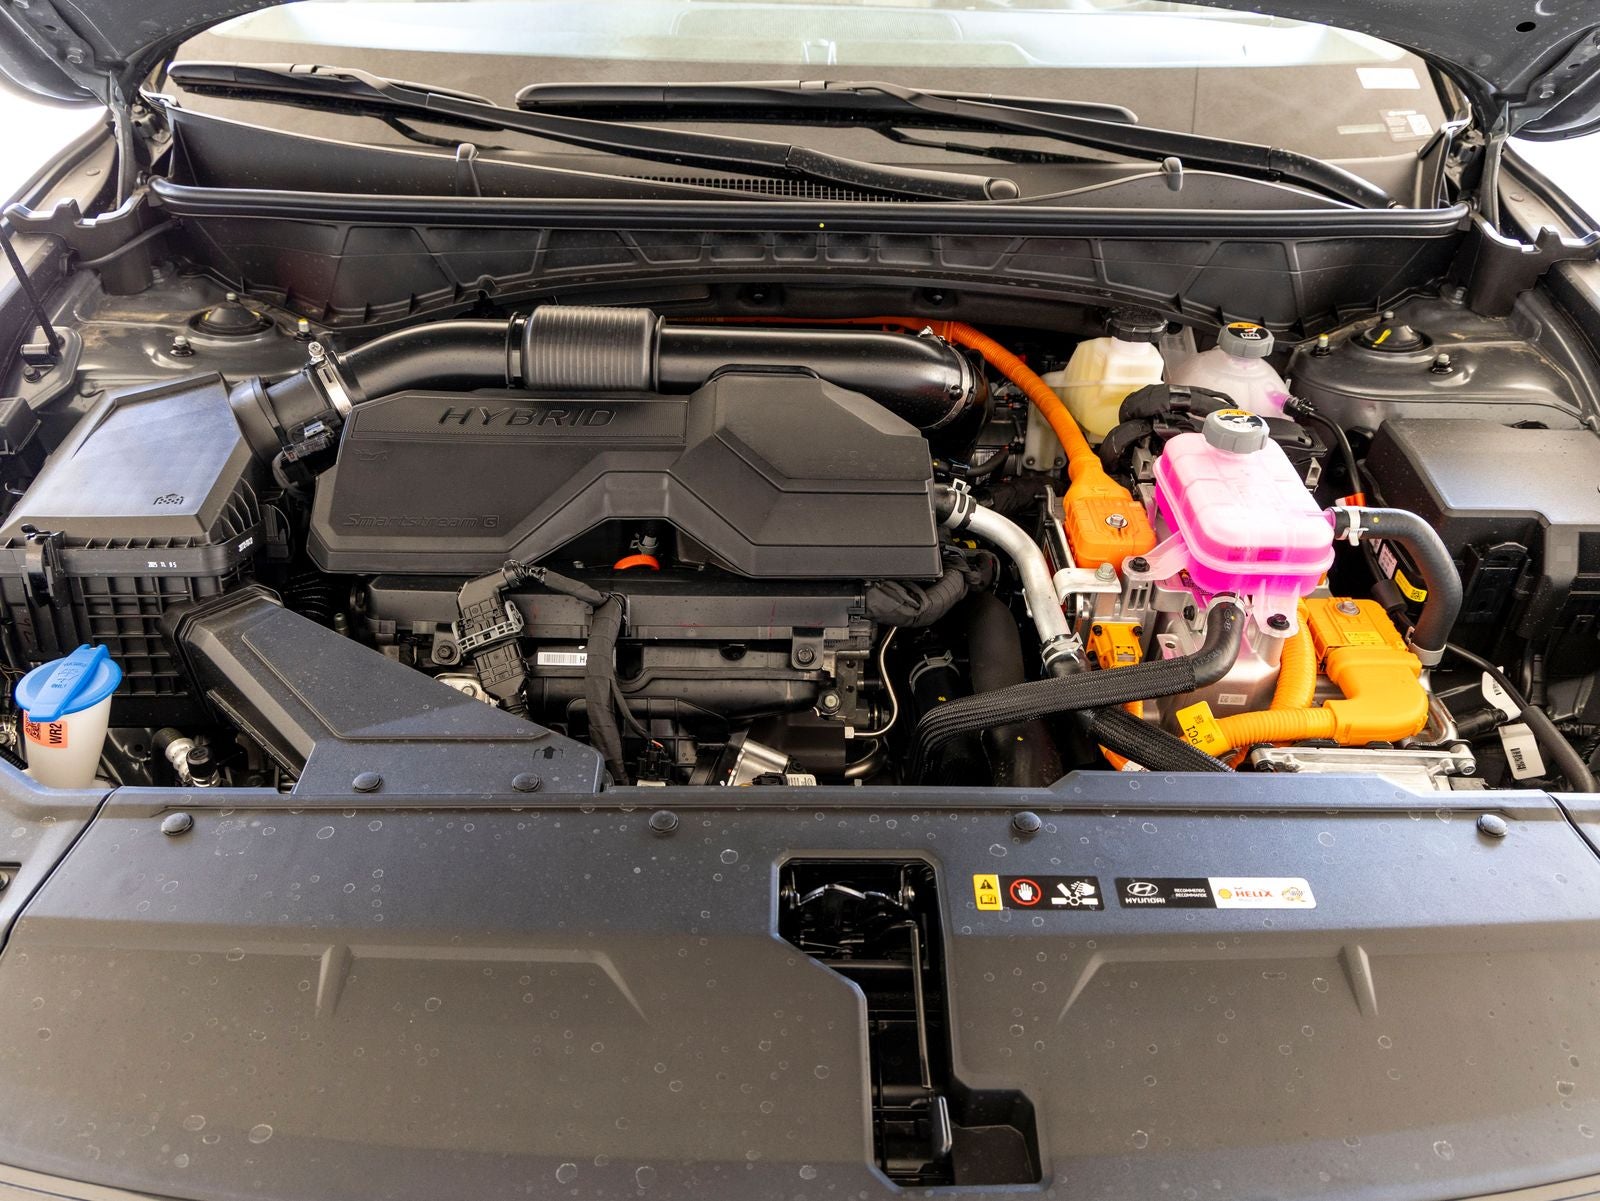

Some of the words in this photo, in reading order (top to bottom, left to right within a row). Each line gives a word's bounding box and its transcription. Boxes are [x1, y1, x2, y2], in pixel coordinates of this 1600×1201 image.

[438, 406, 616, 427] HYBRID
[344, 513, 478, 529] Smartstream
[49, 723, 62, 745] WR2
[1235, 890, 1273, 898] HELIX
